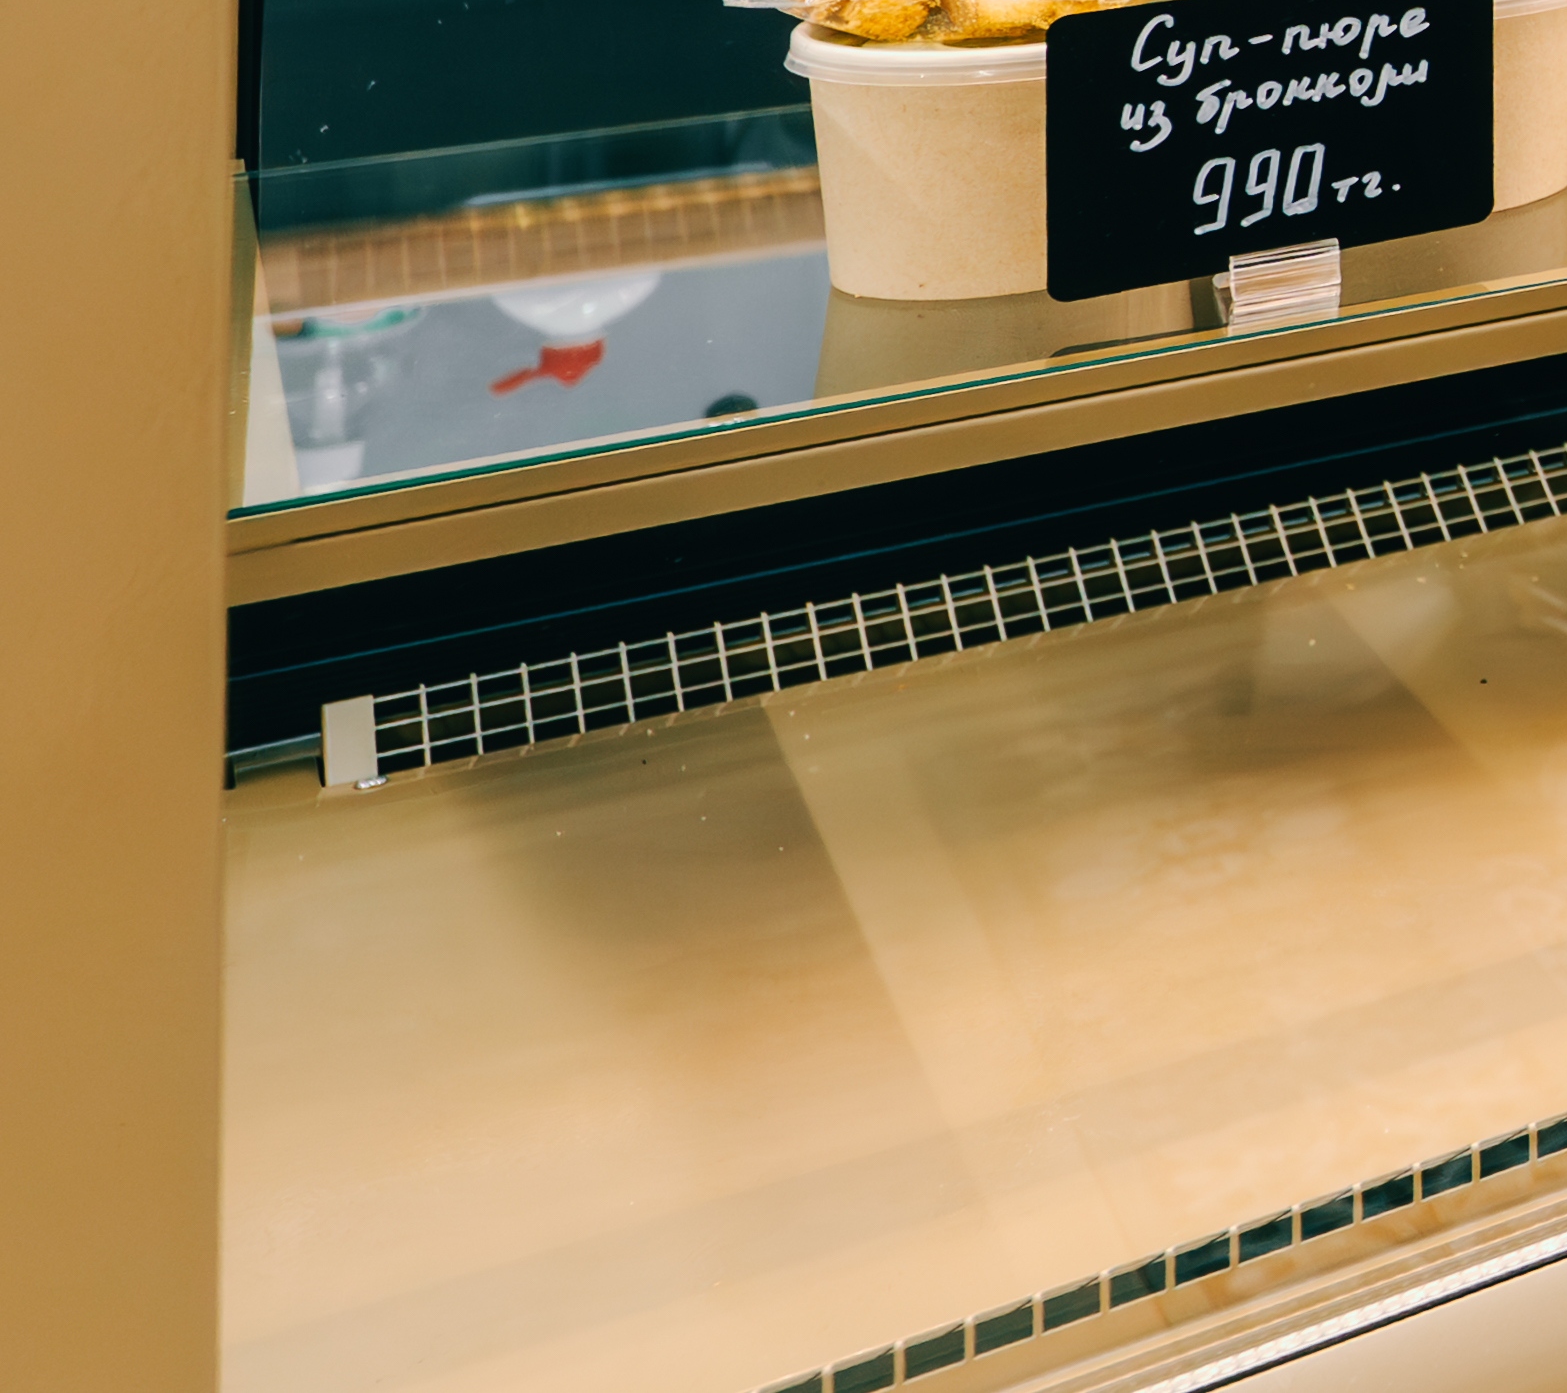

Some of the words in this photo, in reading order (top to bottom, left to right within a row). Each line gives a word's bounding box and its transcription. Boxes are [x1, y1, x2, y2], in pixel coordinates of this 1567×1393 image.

[1130, 5, 1431, 87] Суп-пюре
[1119, 99, 1173, 153] из
[1194, 58, 1430, 135] брокколи
